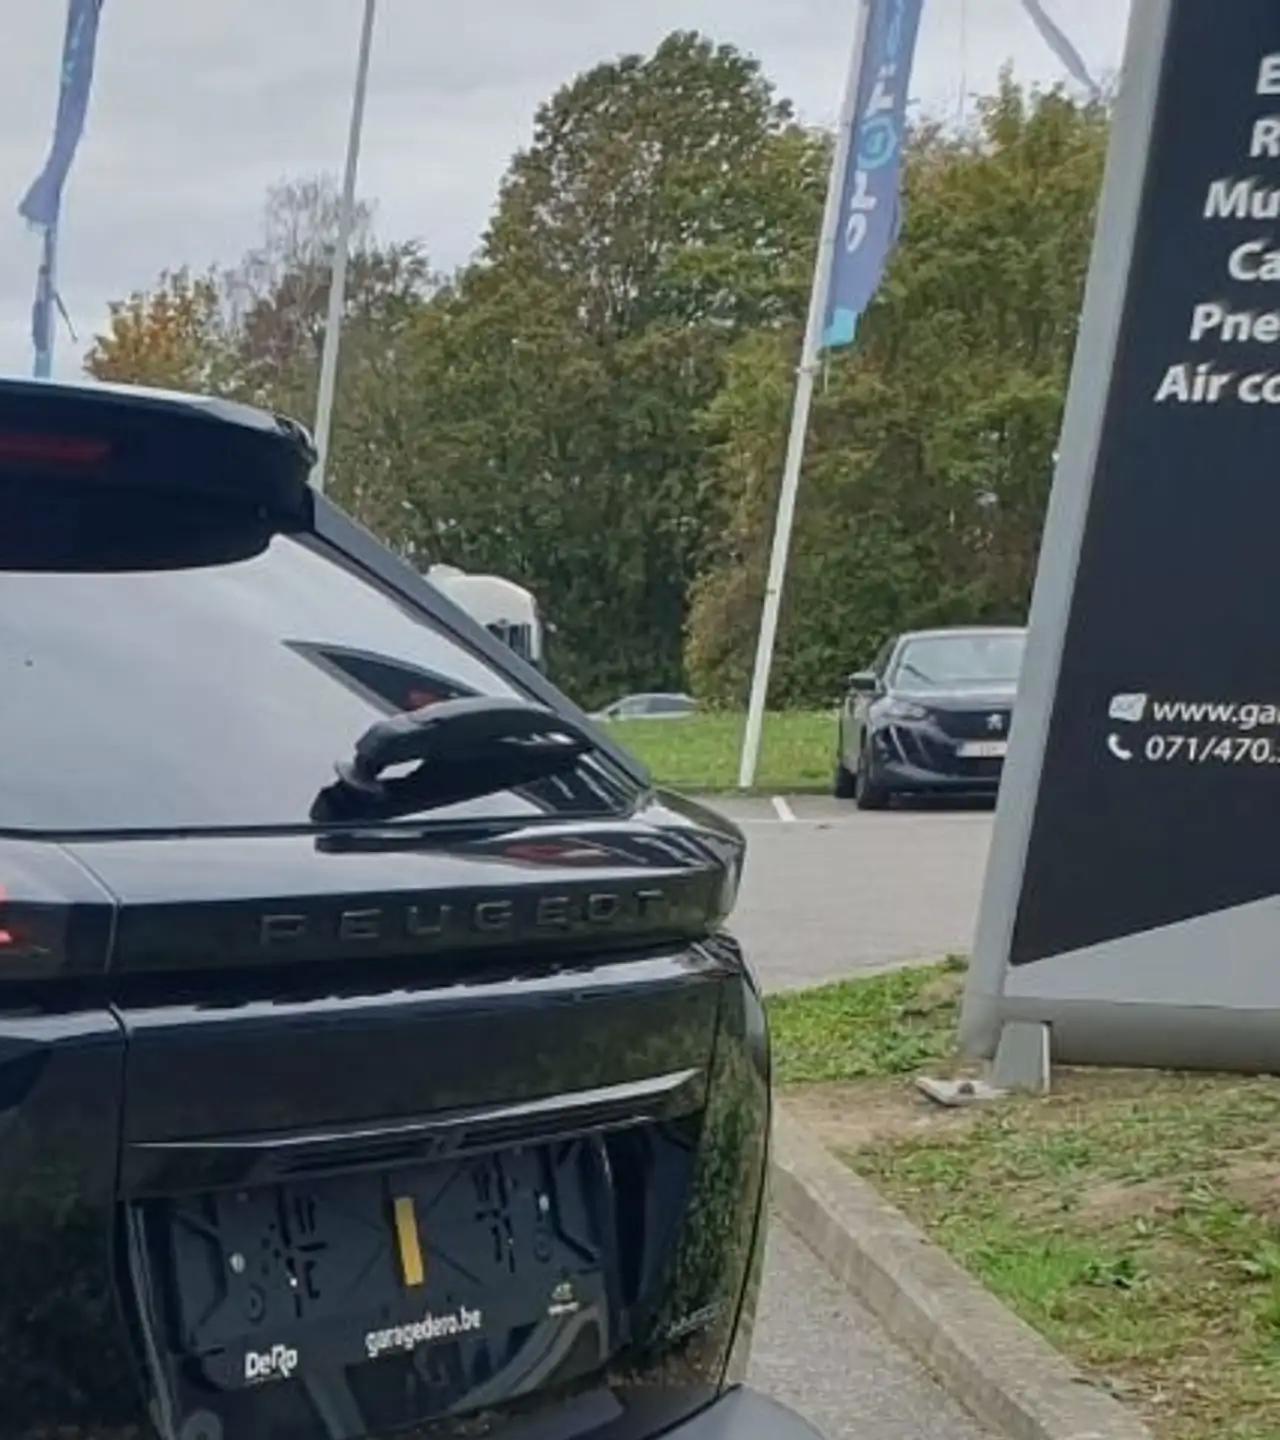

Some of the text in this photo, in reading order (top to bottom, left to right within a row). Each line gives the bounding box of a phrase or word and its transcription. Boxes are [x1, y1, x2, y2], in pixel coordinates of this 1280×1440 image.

[1249, 118, 1280, 157] R
[1203, 177, 1280, 218] Mu
[1228, 239, 1280, 281] Ca
[1189, 302, 1280, 342] Pne
[1154, 361, 1232, 402] Air
[1153, 701, 1280, 730] www.ga
[1145, 734, 1280, 763] 071/470.
[260, 889, 663, 945] PEUGEOT
